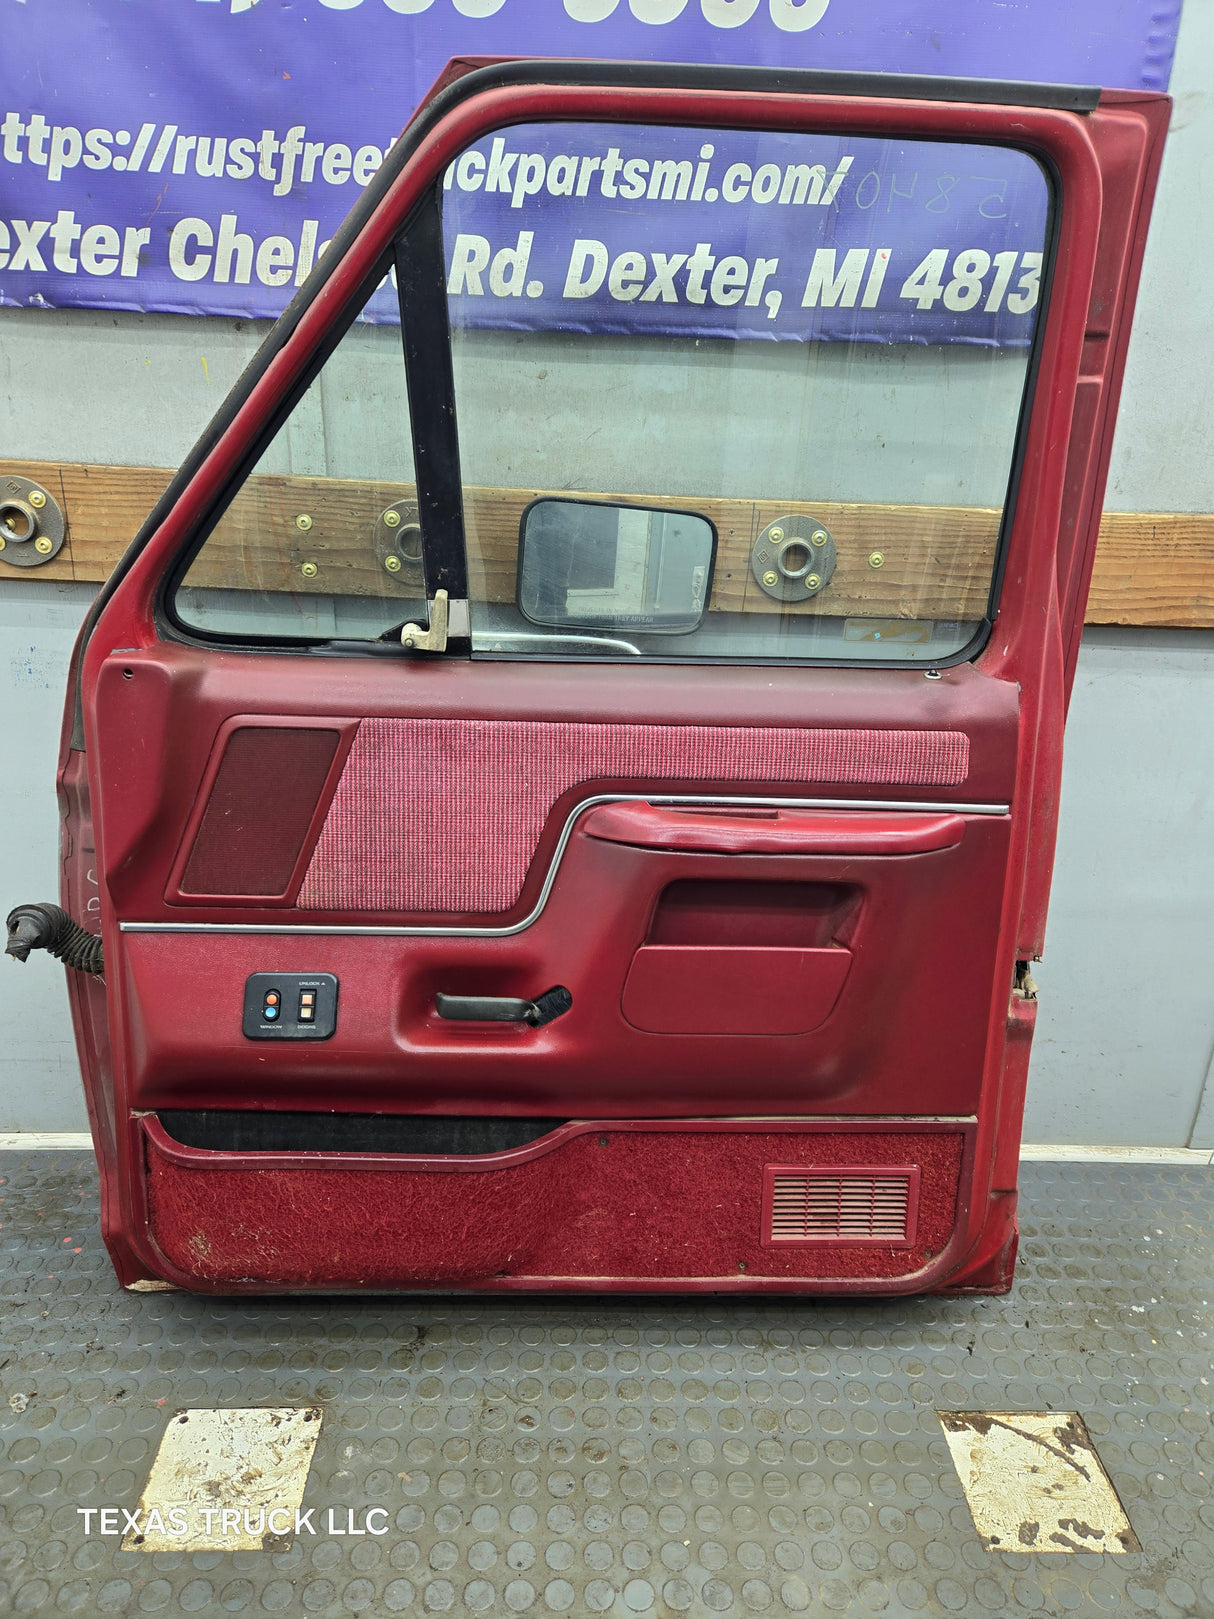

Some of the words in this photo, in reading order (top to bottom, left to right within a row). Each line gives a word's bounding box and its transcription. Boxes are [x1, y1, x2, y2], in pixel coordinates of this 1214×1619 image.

[0, 210, 150, 278] xter
[447, 231, 544, 298] Rd.
[563, 239, 782, 318] Dexter,
[801, 248, 892, 308] MI
